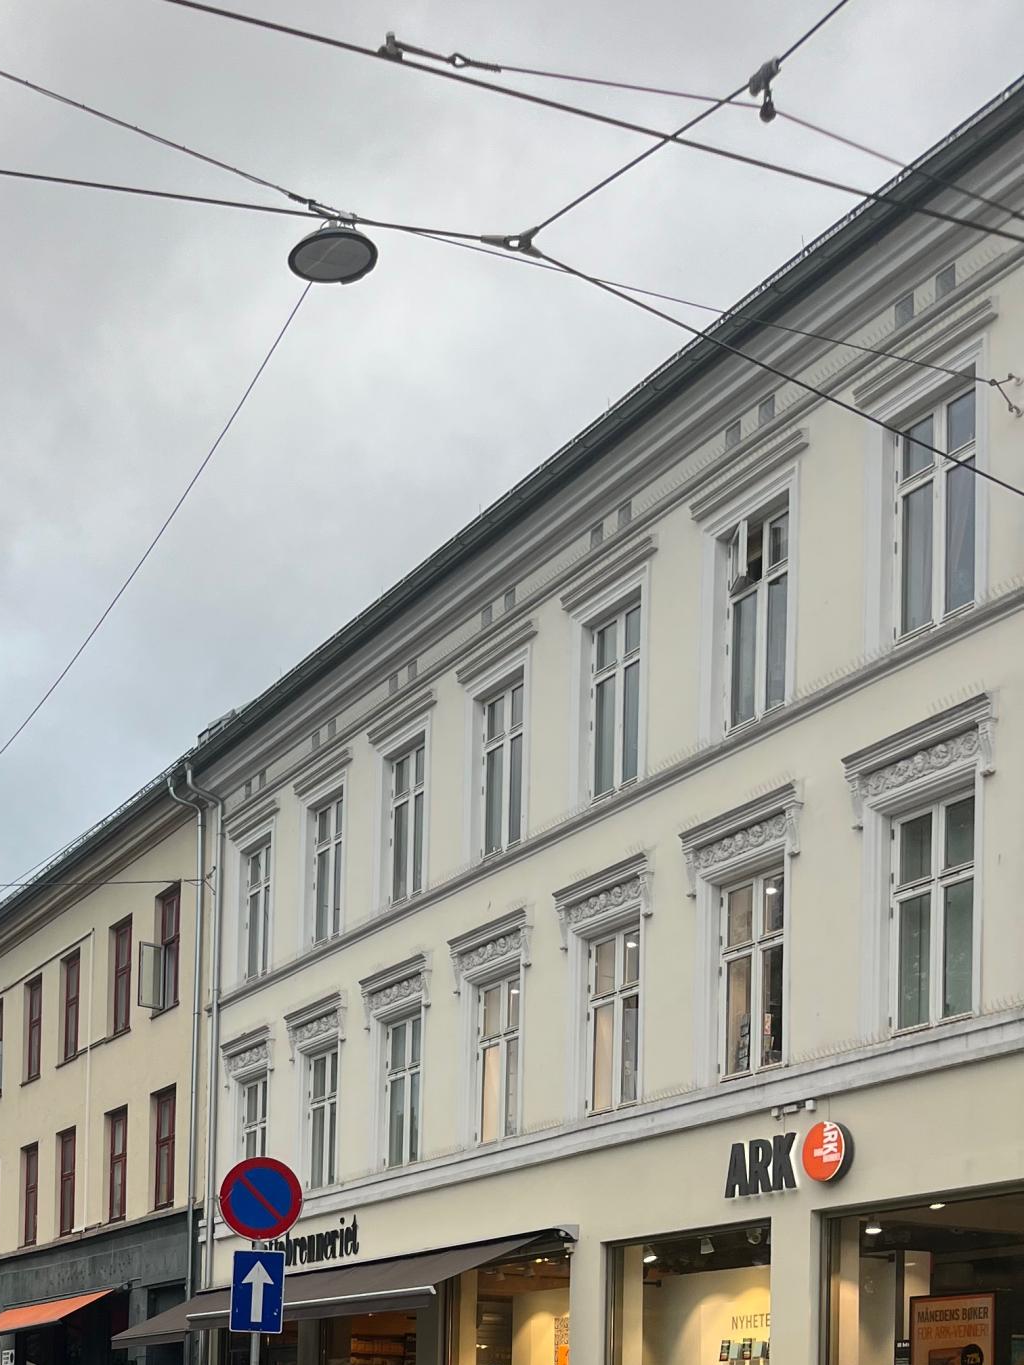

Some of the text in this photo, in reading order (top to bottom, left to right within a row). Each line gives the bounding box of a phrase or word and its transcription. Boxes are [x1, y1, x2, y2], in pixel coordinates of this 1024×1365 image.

[725, 1132, 797, 1198] ARK
[252, 1214, 360, 1267] brenneriet
[917, 1306, 989, 1322] MÅNEDENS BØKER
[918, 1327, 933, 1339] FOR
